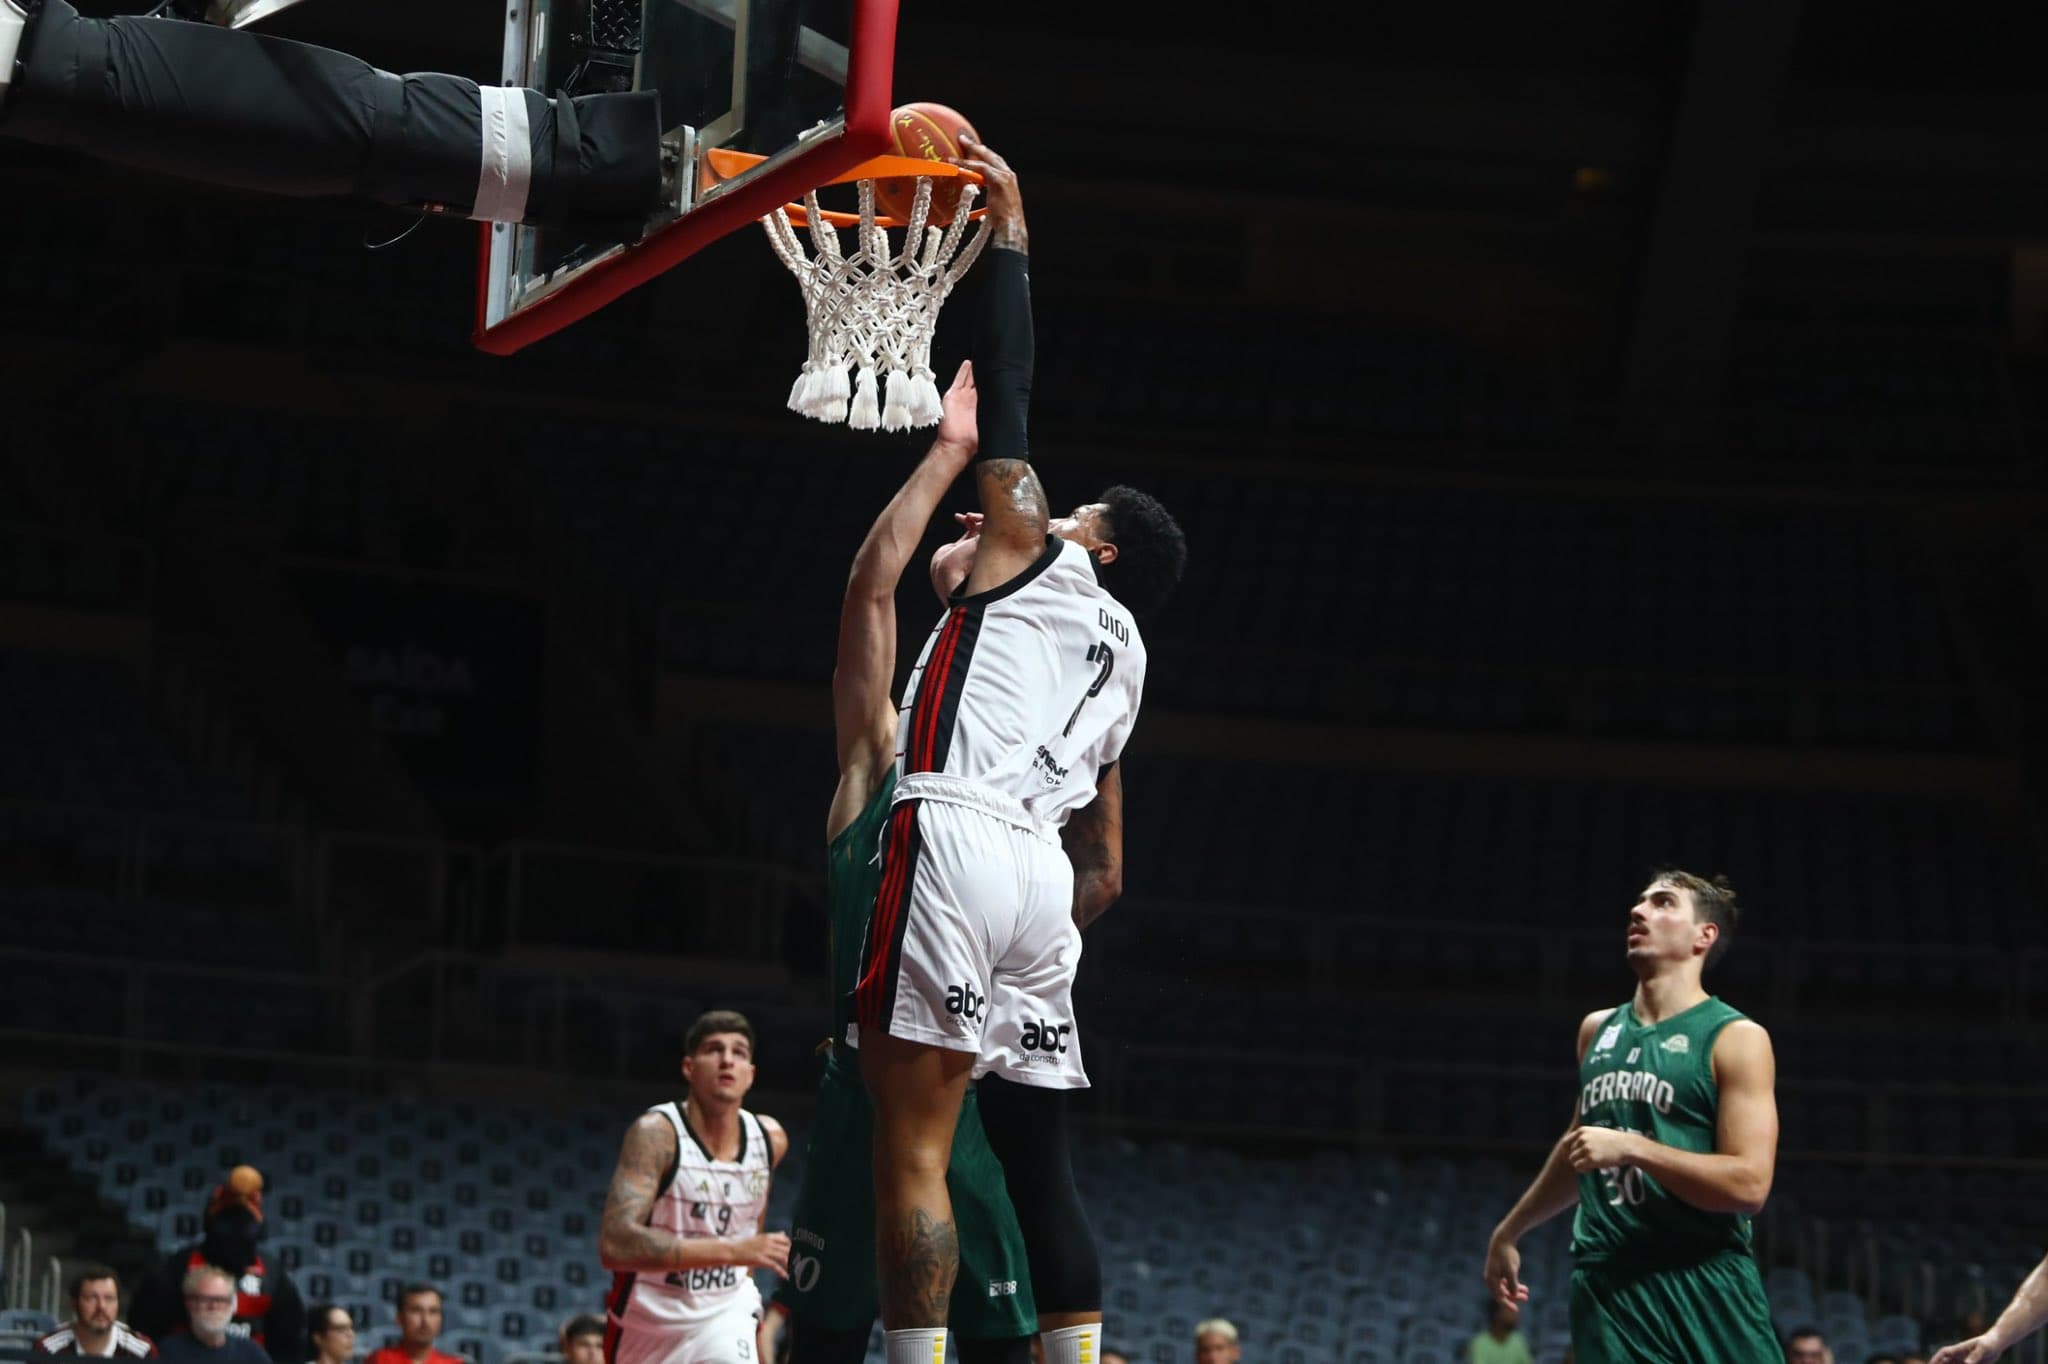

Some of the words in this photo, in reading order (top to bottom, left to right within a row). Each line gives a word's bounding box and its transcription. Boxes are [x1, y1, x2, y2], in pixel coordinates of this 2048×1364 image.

[1099, 607, 1130, 648] DIDI
[1062, 640, 1115, 738] 7
[945, 982, 985, 1025] abc
[1020, 1018, 1071, 1054] abc
[1580, 1070, 1675, 1116] CERRADO
[716, 1205, 732, 1235] 9
